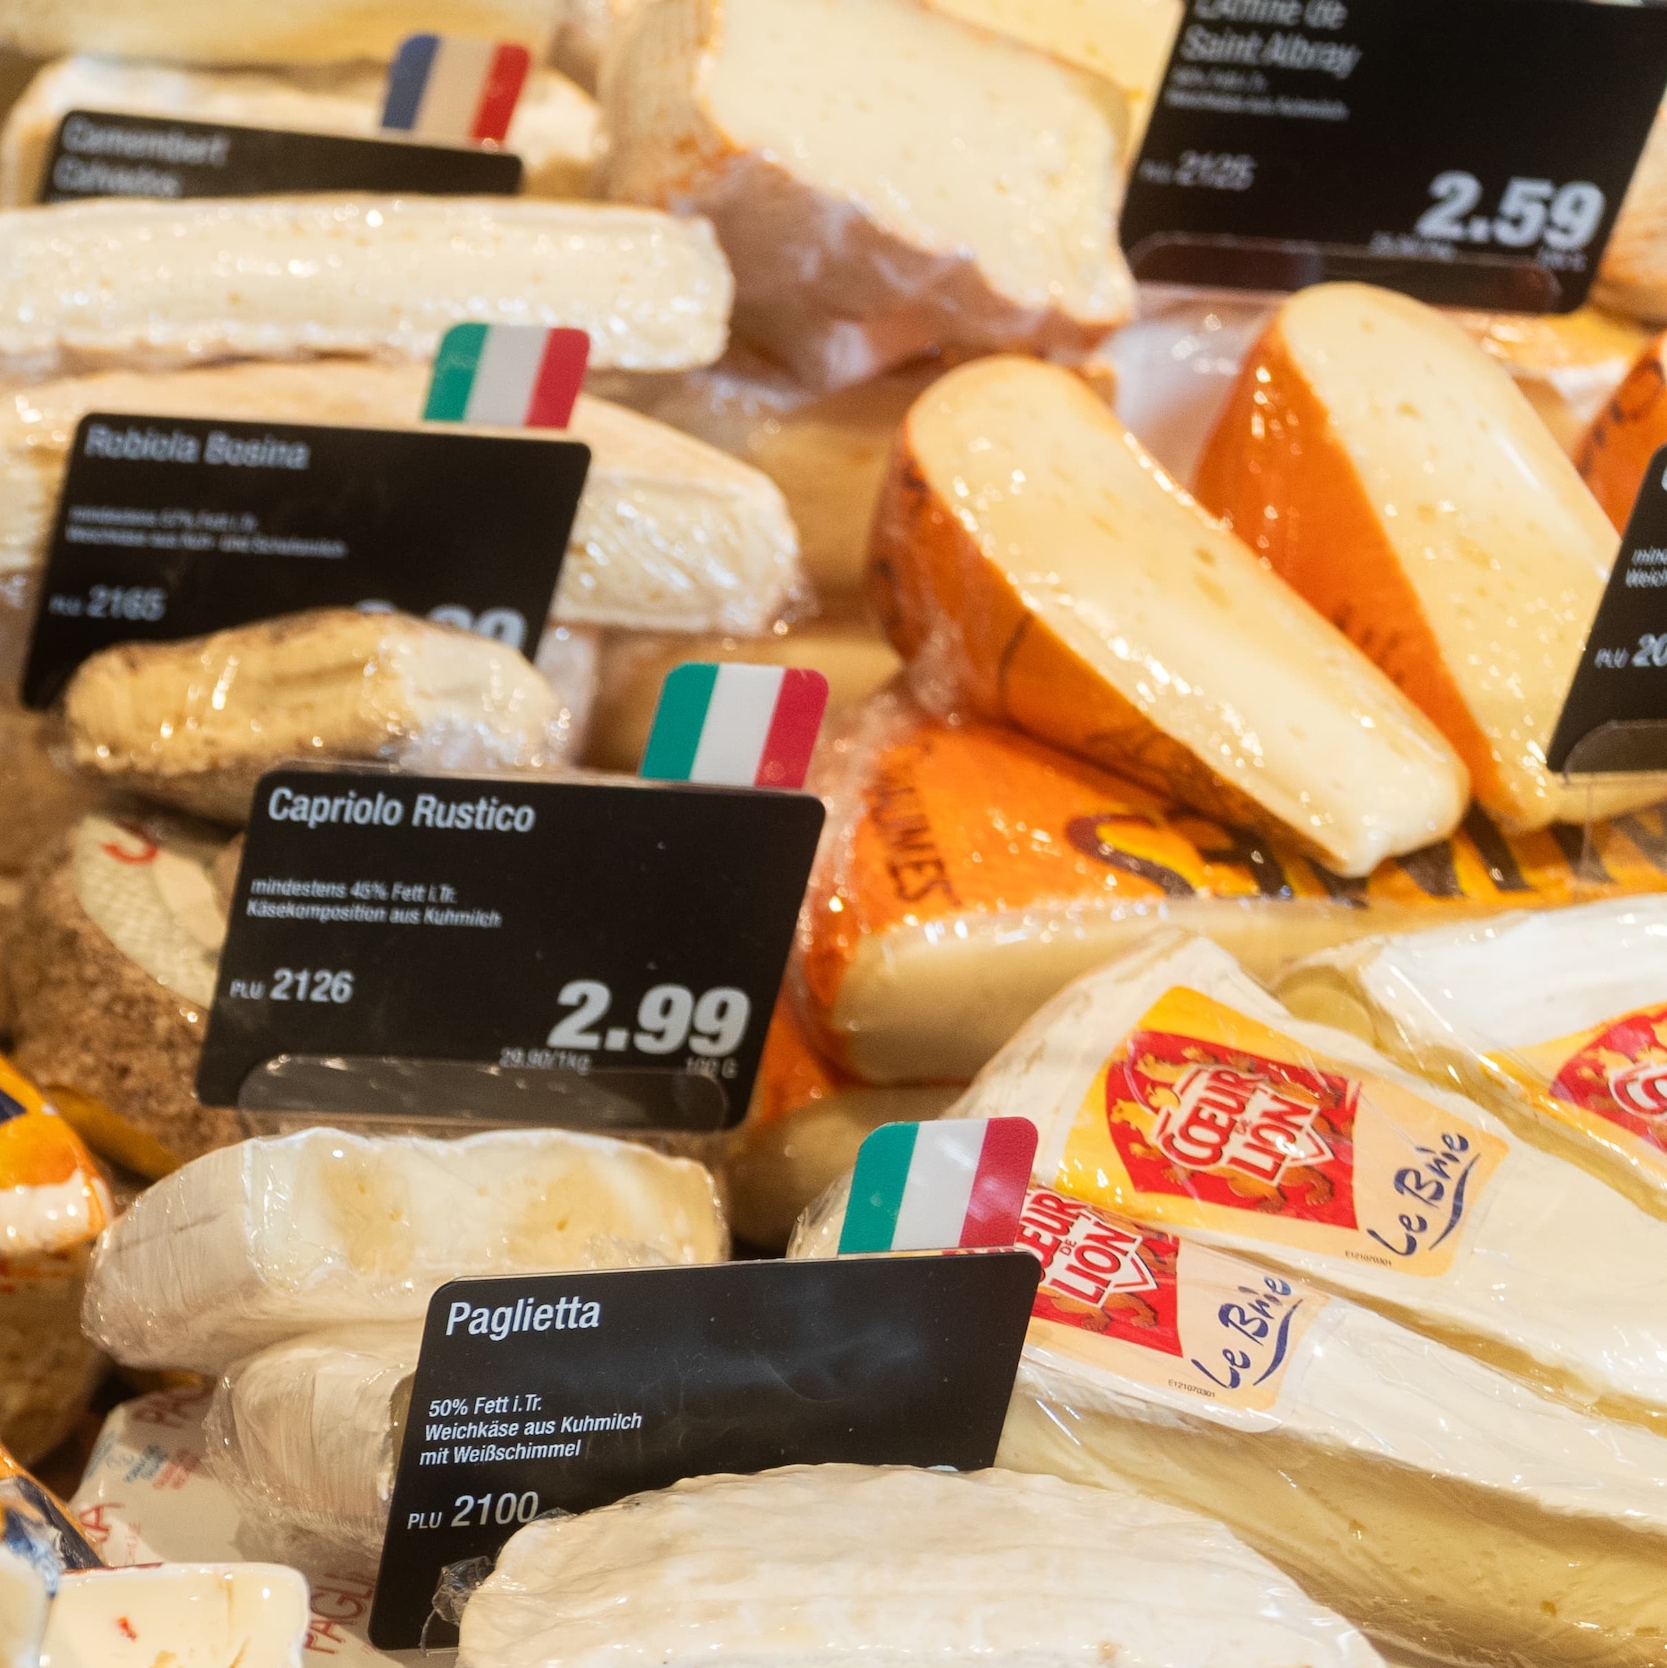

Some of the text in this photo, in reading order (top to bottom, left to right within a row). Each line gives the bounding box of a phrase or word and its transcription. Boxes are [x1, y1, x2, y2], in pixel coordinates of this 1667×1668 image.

[1413, 170, 1606, 250] 2.59
[268, 787, 535, 832] Capriolo Rustico
[246, 899, 501, 928] Käsekomposition aus Kuhmilch
[229, 968, 354, 1004] PLU 2126
[547, 980, 752, 1057] 2.99
[1226, 1093, 1313, 1182] LION
[1367, 1132, 1470, 1257] Le Brie
[1049, 1221, 1137, 1306] LION
[1060, 1240, 1078, 1257] DE
[445, 1295, 601, 1342] Paglietta
[1191, 1275, 1293, 1389] Le Brie
[425, 1412, 643, 1441] Weichkäse aus Kuhmilch
[428, 1393, 542, 1418] 50% Fett i.Tr.
[419, 1439, 582, 1466] mit Weißschimmel
[407, 1491, 540, 1530] PLU 2100
